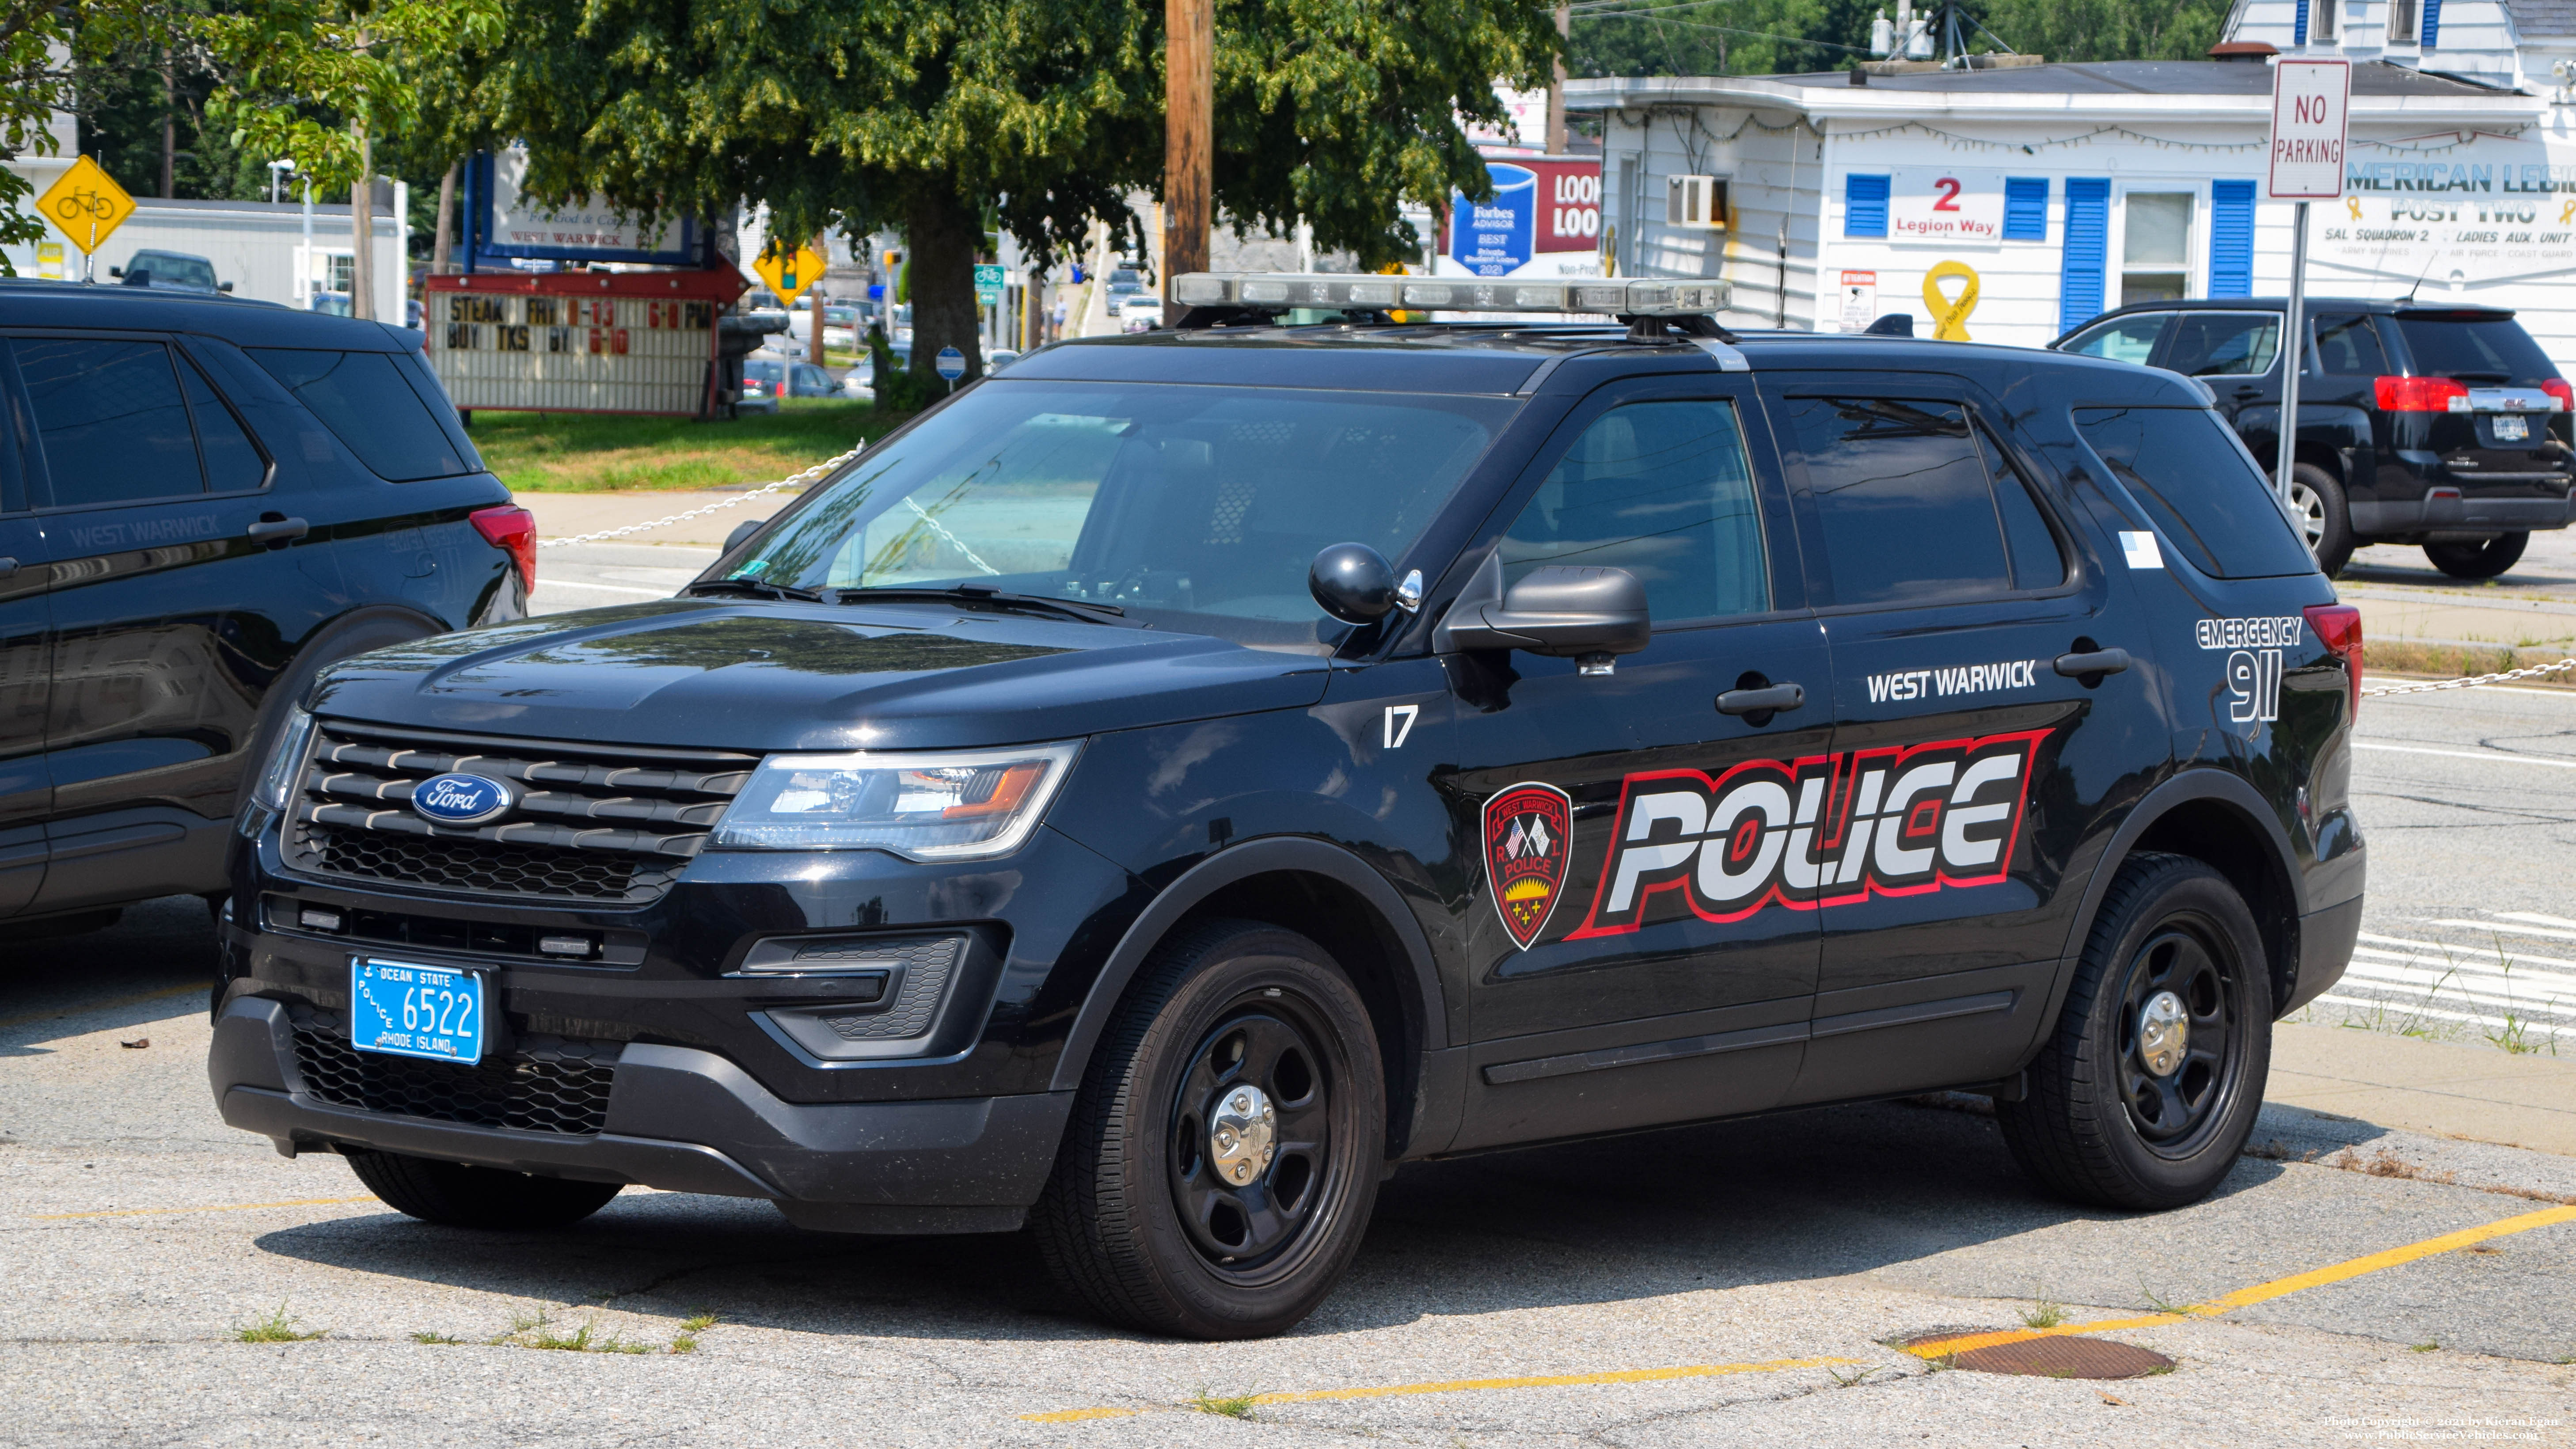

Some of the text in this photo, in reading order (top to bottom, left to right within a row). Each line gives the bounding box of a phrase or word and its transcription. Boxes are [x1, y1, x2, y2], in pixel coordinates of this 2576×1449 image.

[2295, 95, 2326, 124] NO
[2276, 139, 2339, 163] PARKING
[1933, 177, 1961, 211] 2
[1474, 206, 1515, 218] Forbes
[2392, 198, 2537, 224] POST TWO
[1472, 219, 1515, 229] ADVISOR
[1897, 217, 1994, 236] Legion Way
[2325, 228, 2349, 240] SAL
[511, 230, 547, 243] WEST
[1478, 234, 1507, 245] BEST
[2456, 230, 2499, 243] LADIES
[1478, 248, 1506, 256] Private
[2341, 246, 2366, 255] ARMY
[2371, 247, 2410, 256] MARINES
[2450, 249, 2464, 257] AIR
[2508, 249, 2537, 258] COAST
[1480, 265, 1504, 275] 2021
[450, 296, 504, 322] STEAK
[526, 297, 556, 324] FRY
[447, 323, 479, 349] BUY
[497, 324, 529, 351] TKS
[550, 327, 569, 352] BY
[69, 514, 221, 548] WEST WARWICK
[2196, 617, 2302, 650] EMERGENCY
[1868, 659, 2036, 703] WEST WARWICK
[2227, 649, 2283, 723] 911
[1384, 704, 1418, 749] 17
[426, 779, 483, 810] Ford
[1501, 799, 1554, 818] WEST WARWICK
[1606, 753, 2021, 913] POLICE
[1497, 839, 1560, 863] R. I.
[1505, 856, 1552, 879] POLICE
[380, 968, 451, 988] OCEAN STATE
[358, 980, 393, 1029] POLICE
[403, 987, 473, 1038] 6522
[381, 1031, 451, 1053] RHODE ISLAND
